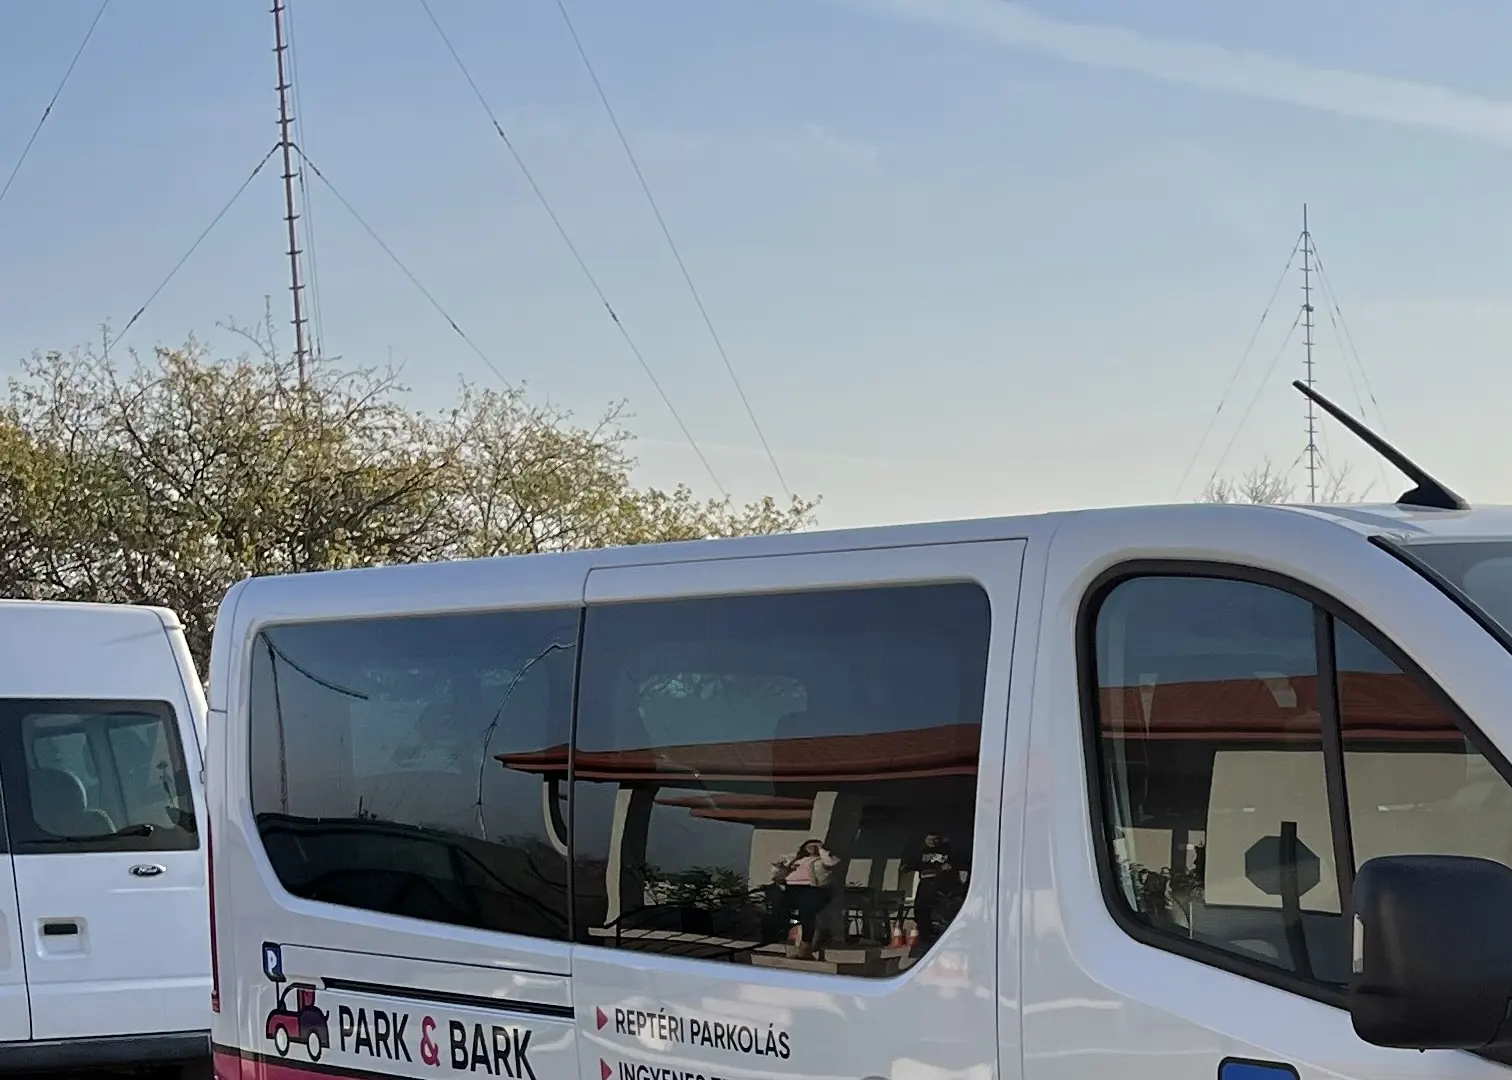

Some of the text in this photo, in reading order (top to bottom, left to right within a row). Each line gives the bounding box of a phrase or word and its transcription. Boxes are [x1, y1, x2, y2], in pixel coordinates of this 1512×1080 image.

[266, 949, 278, 976] P
[338, 1004, 537, 1080] PARK & BARK
[615, 1007, 791, 1060] REPTÉRI PARKOLÁS
